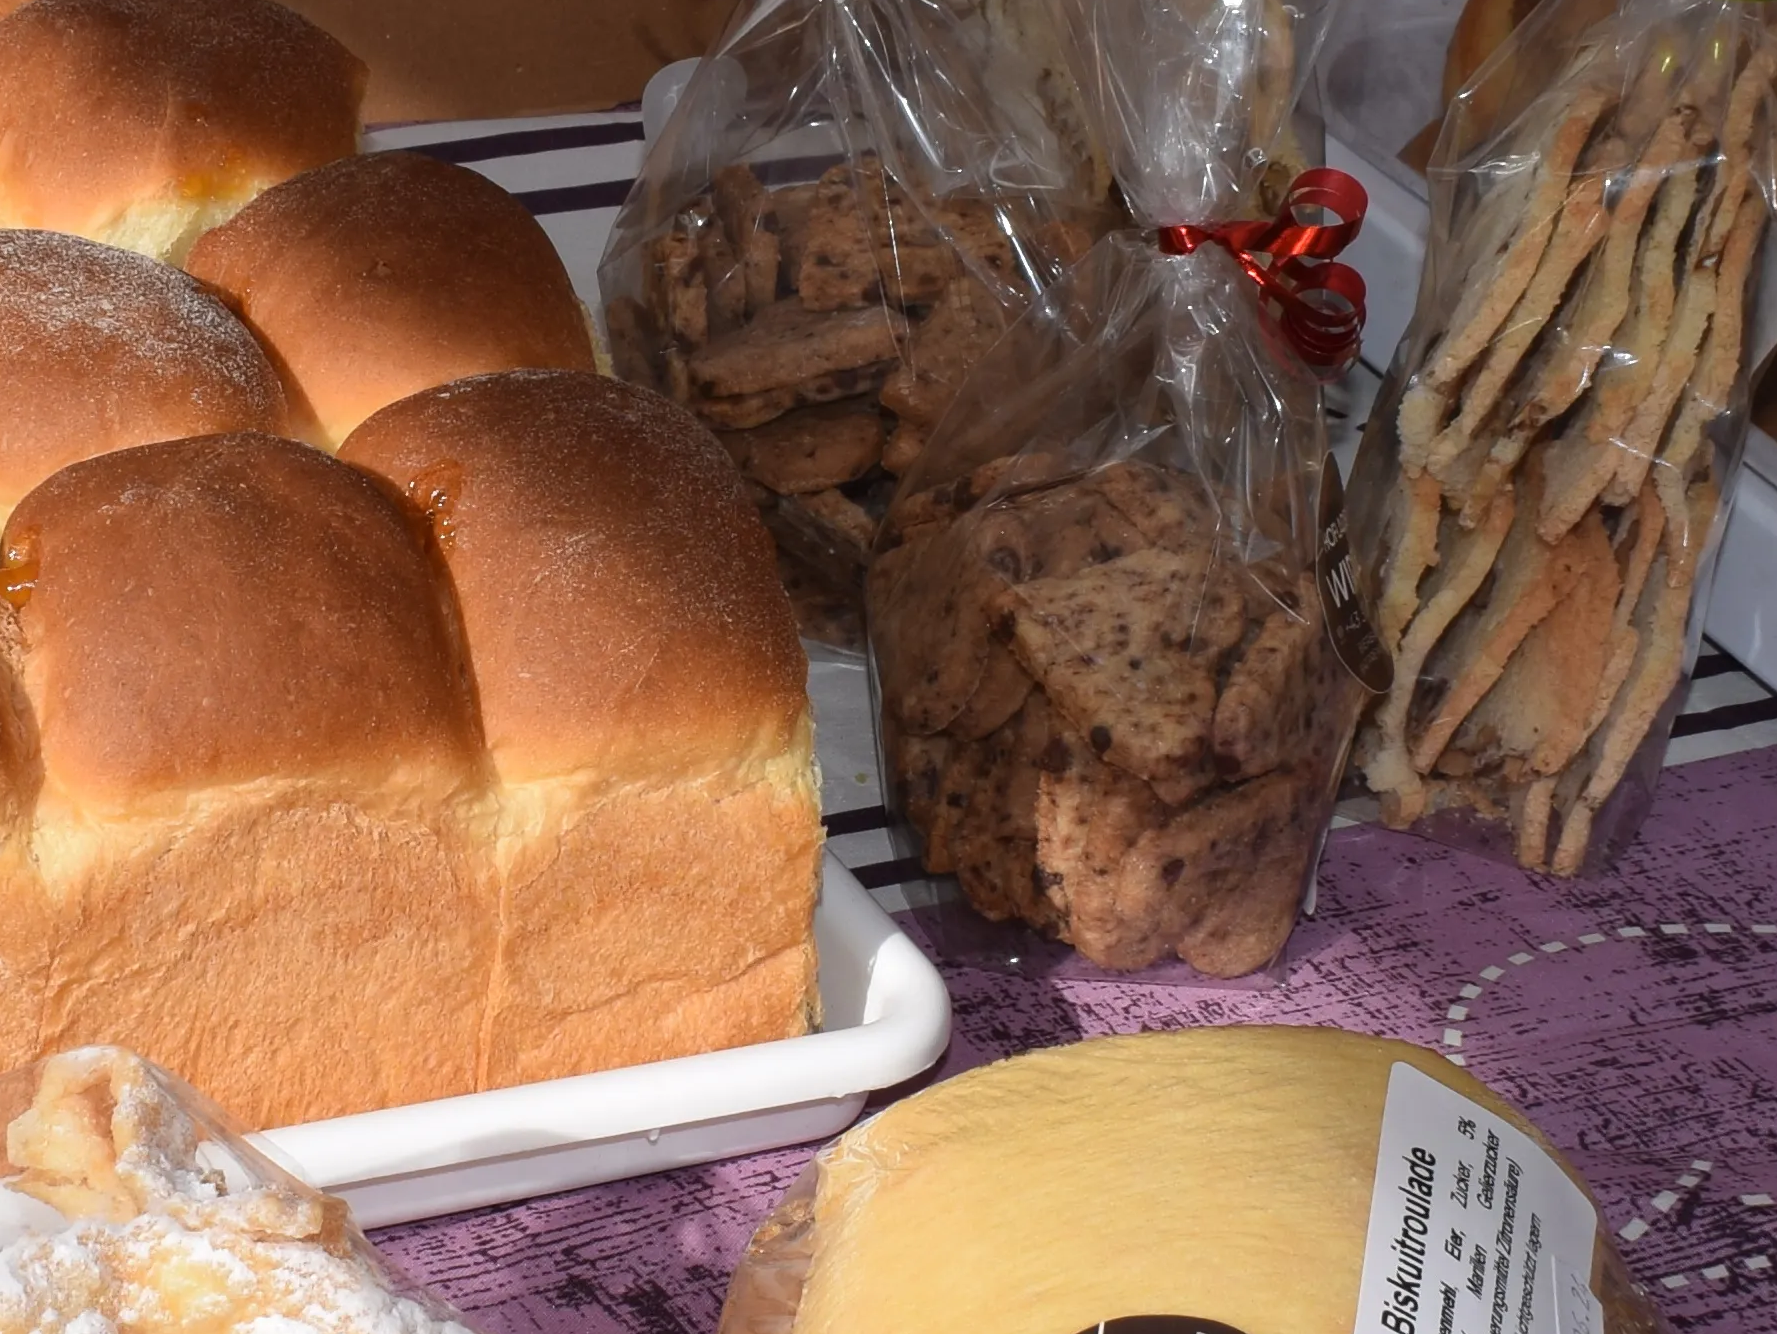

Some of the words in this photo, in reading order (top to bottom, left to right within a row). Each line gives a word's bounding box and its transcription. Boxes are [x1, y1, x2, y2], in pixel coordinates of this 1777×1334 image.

[1458, 1116, 1476, 1140] 5%
[1450, 1161, 1473, 1209] Zucker,
[1496, 1158, 1522, 1255] Zitronensäure)
[1467, 1244, 1487, 1299] Marillen
[1477, 1130, 1499, 1209] Gelierzucker
[1445, 1228, 1466, 1261] Eier,
